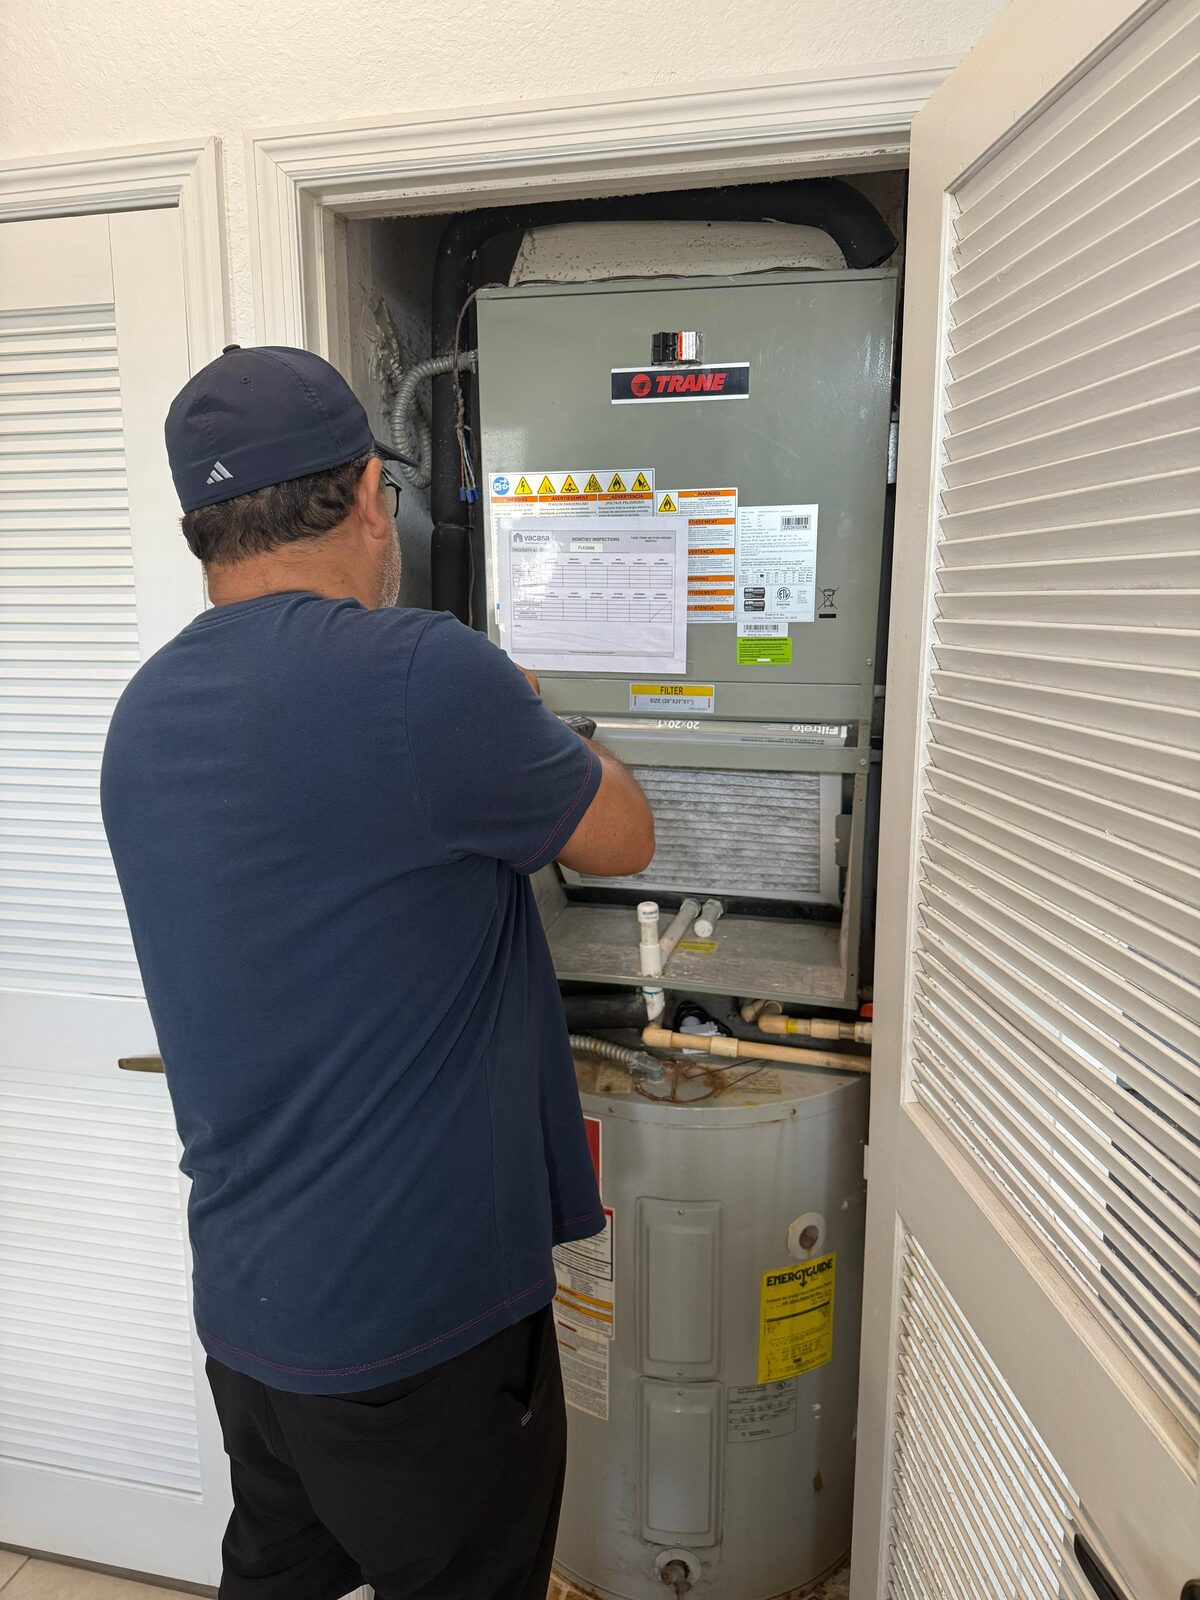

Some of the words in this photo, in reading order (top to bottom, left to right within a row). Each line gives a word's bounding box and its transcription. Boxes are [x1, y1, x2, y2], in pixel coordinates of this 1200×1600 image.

[655, 373, 726, 393] TRANE
[523, 534, 550, 542] vacasa
[660, 686, 684, 695] FILTER
